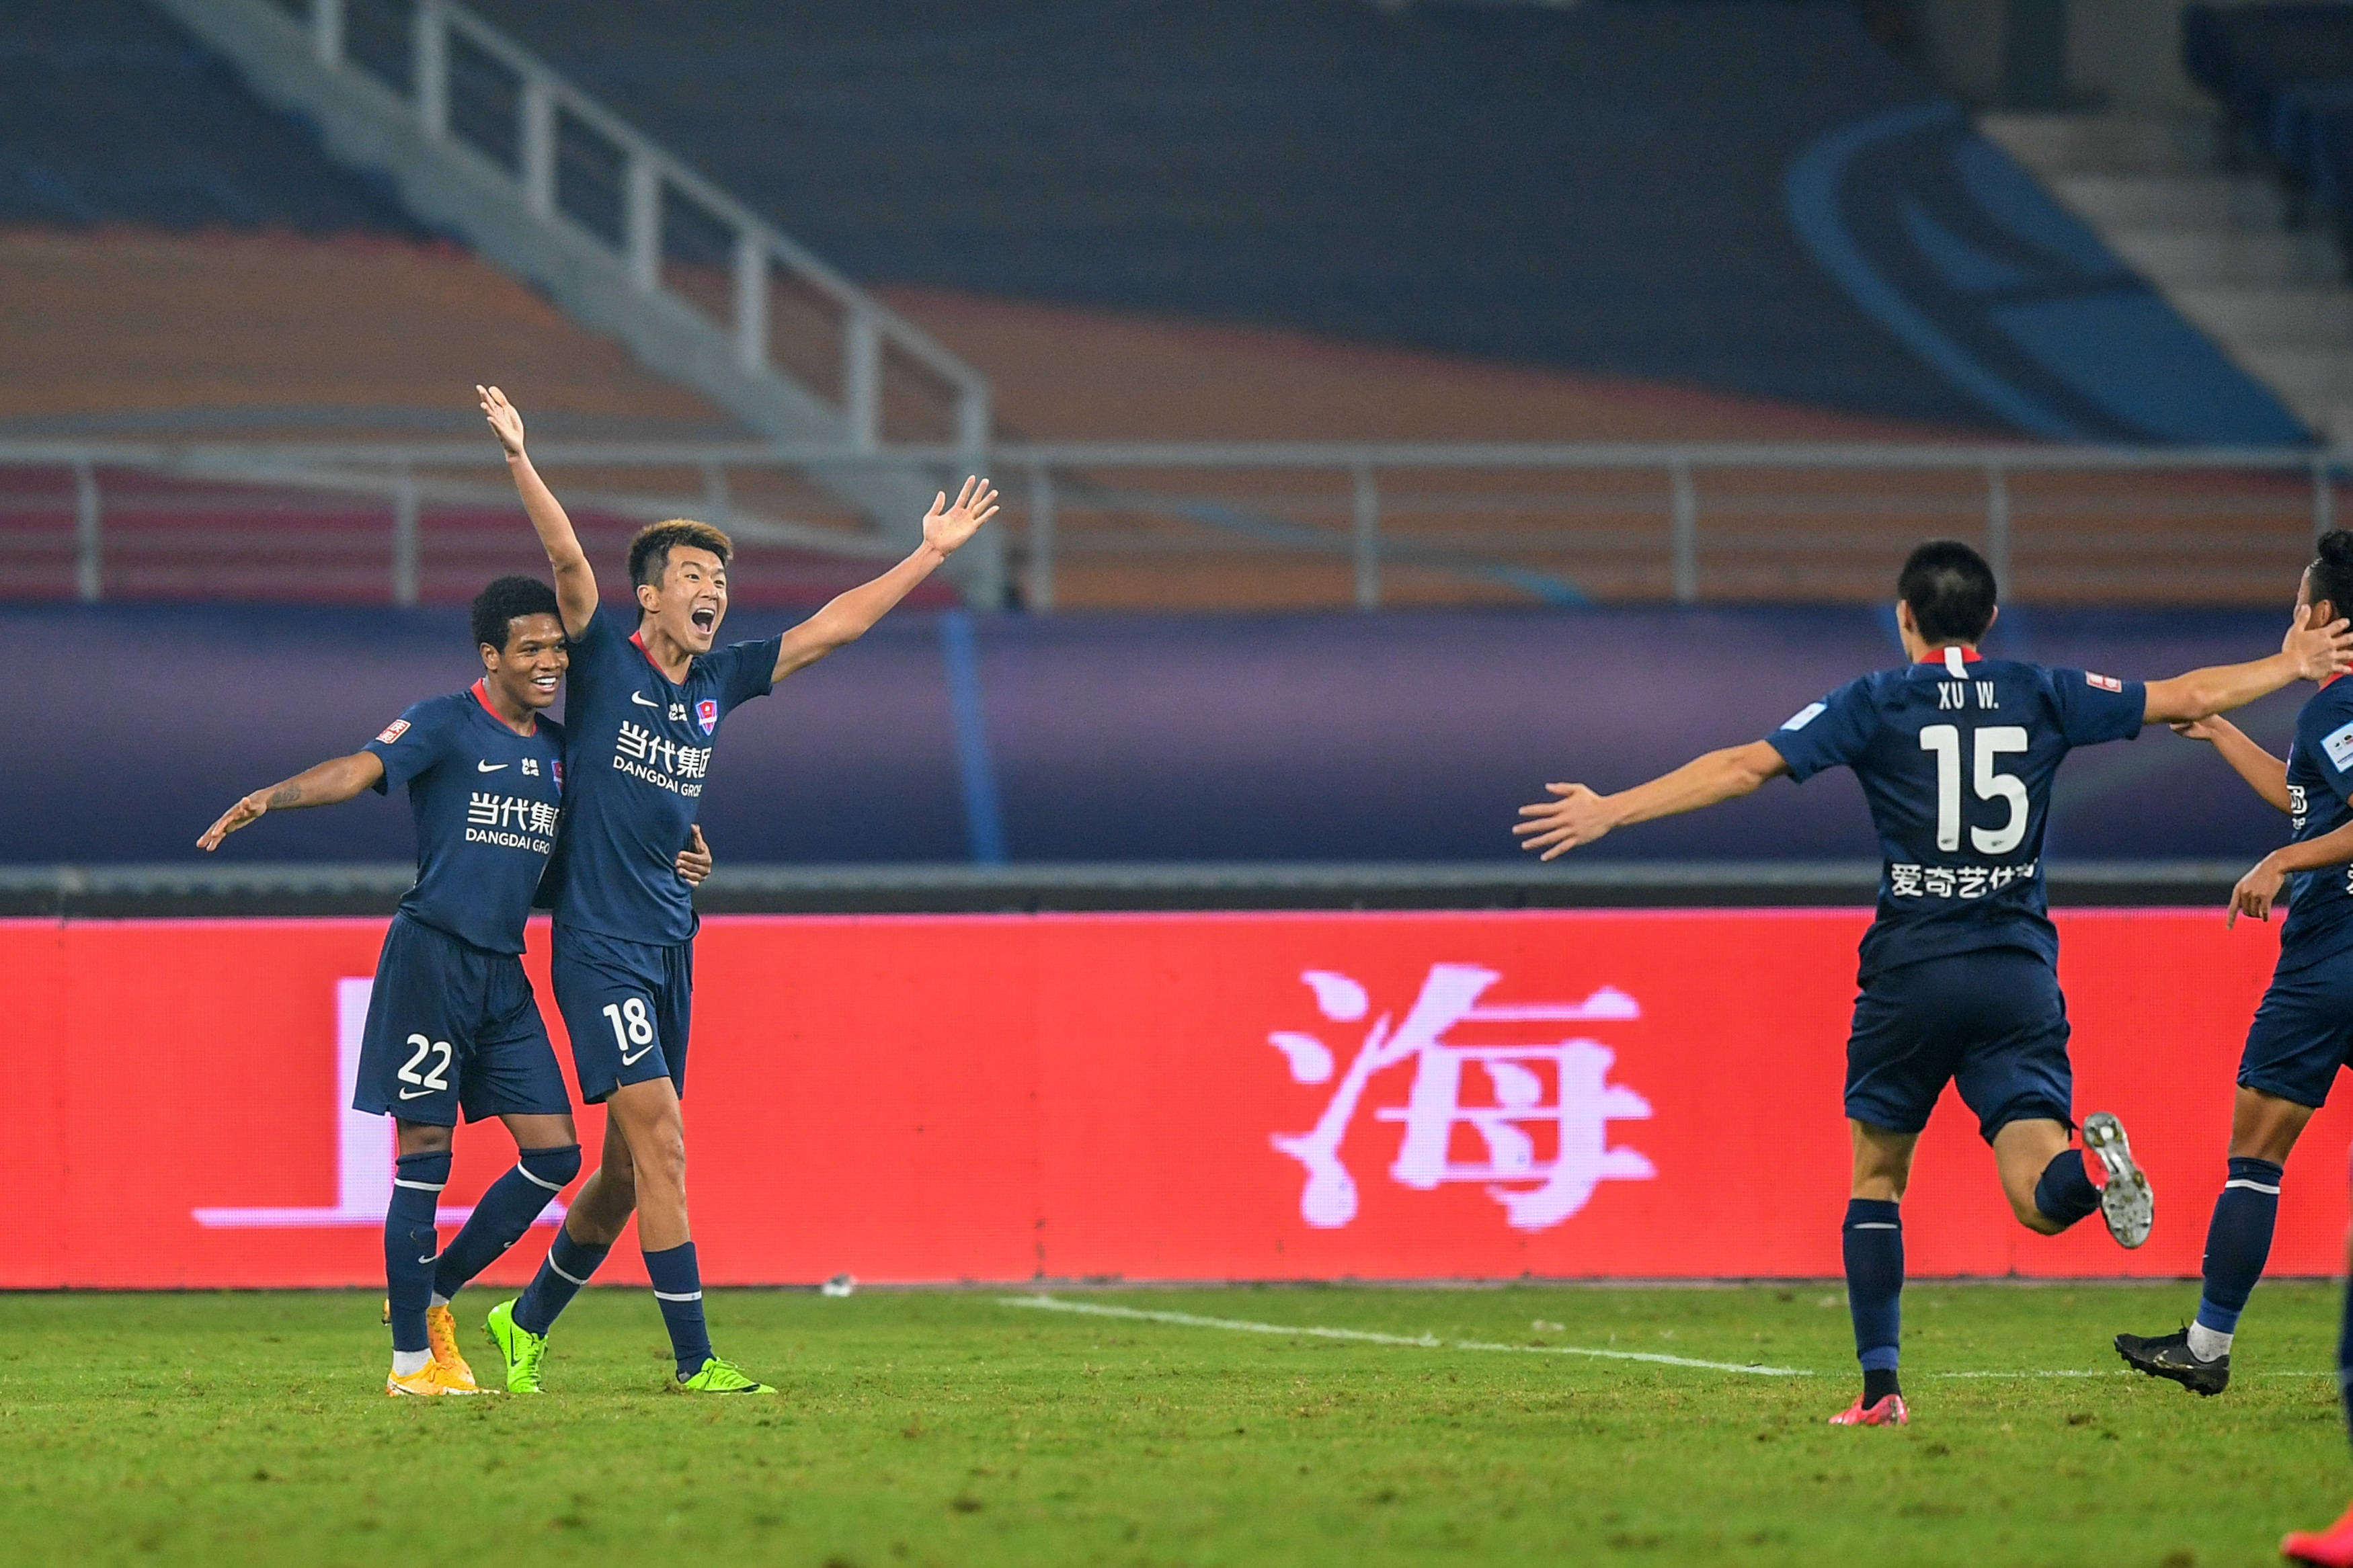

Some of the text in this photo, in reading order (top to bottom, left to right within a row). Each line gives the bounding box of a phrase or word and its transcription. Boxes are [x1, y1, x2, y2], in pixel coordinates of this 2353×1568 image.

[1937, 681, 1999, 710] XU W.
[612, 755, 678, 794] DANGDAI
[1919, 724, 2029, 854] 15
[465, 828, 530, 850] DANGDAI
[467, 792, 560, 837] 当代集
[602, 997, 653, 1051] 18
[397, 1033, 452, 1091] 22
[1268, 962, 1659, 1233] 海
